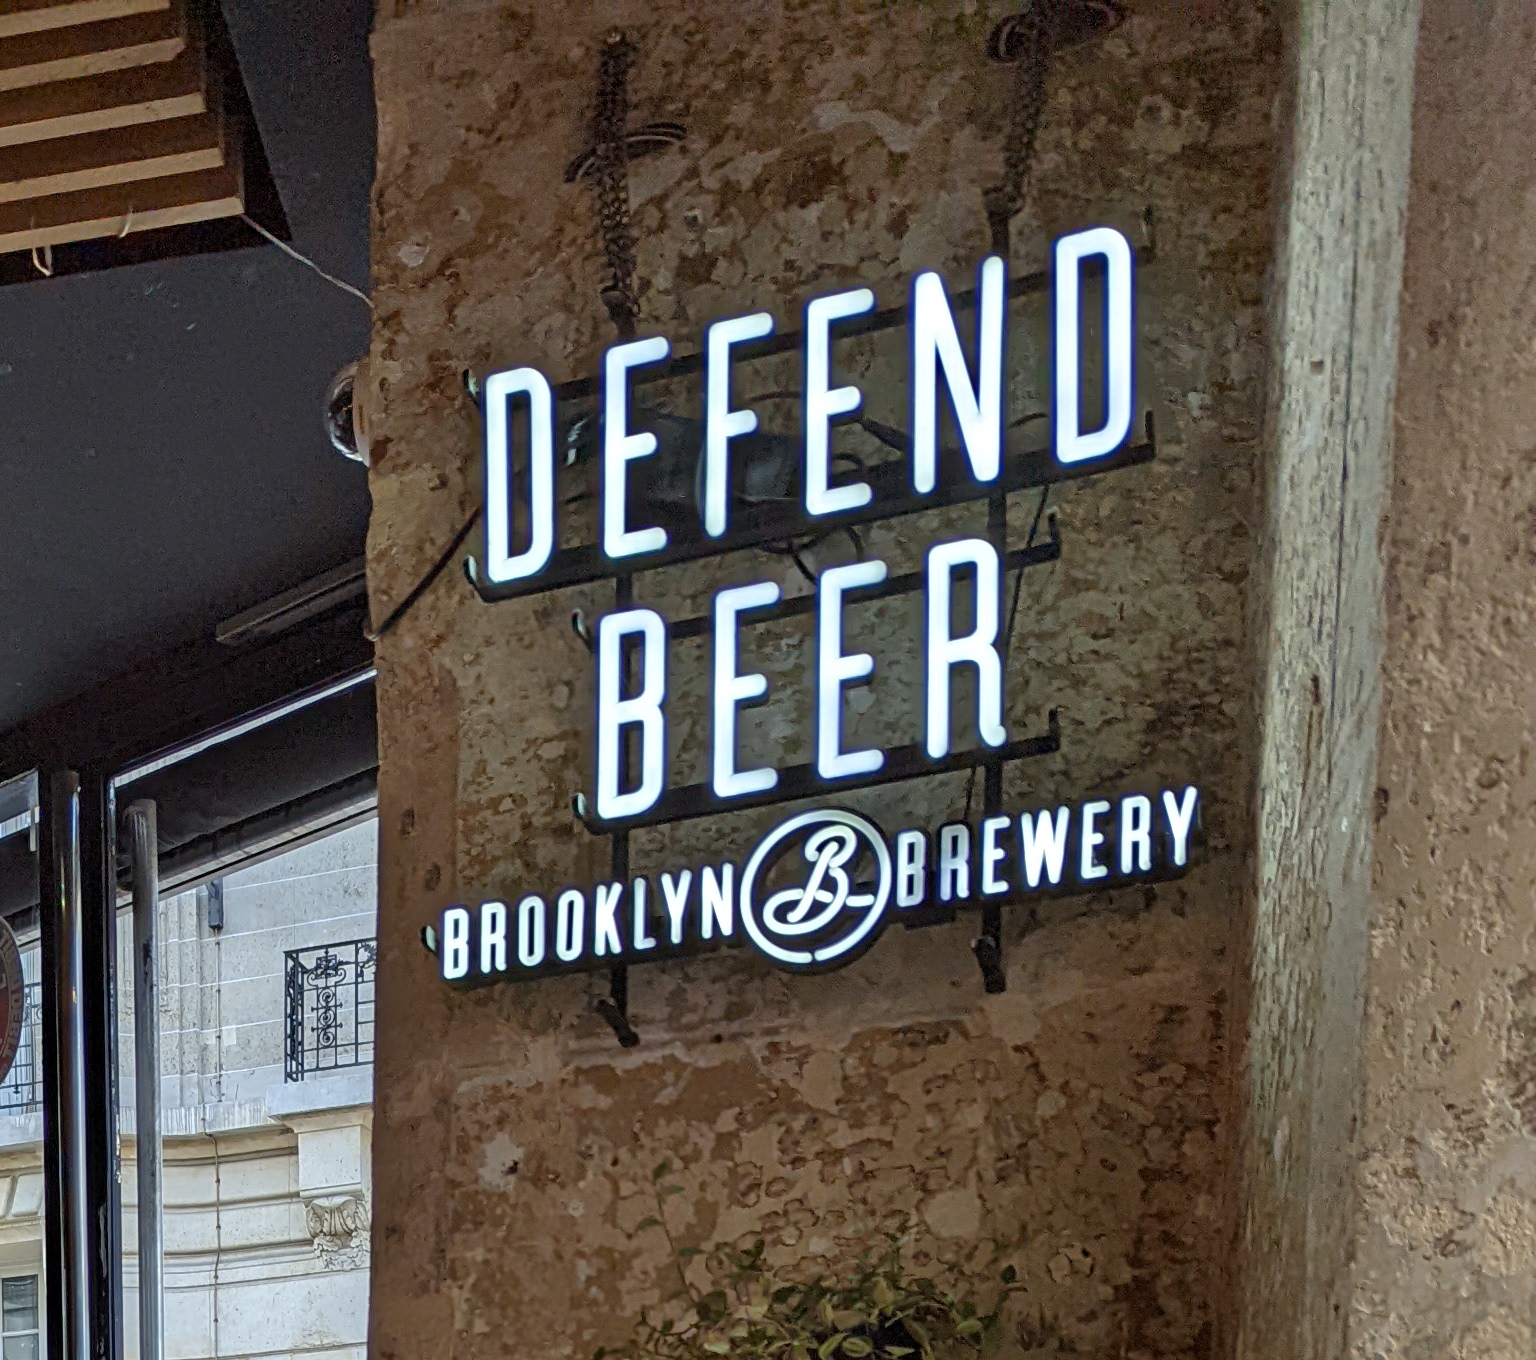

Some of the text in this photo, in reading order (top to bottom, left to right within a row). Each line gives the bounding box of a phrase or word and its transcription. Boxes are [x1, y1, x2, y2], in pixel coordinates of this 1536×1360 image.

[482, 225, 1133, 584] DEFEND
[595, 538, 1006, 821] BEER
[442, 861, 734, 980] BROOKLYN
[896, 785, 1200, 910] BREWERY
